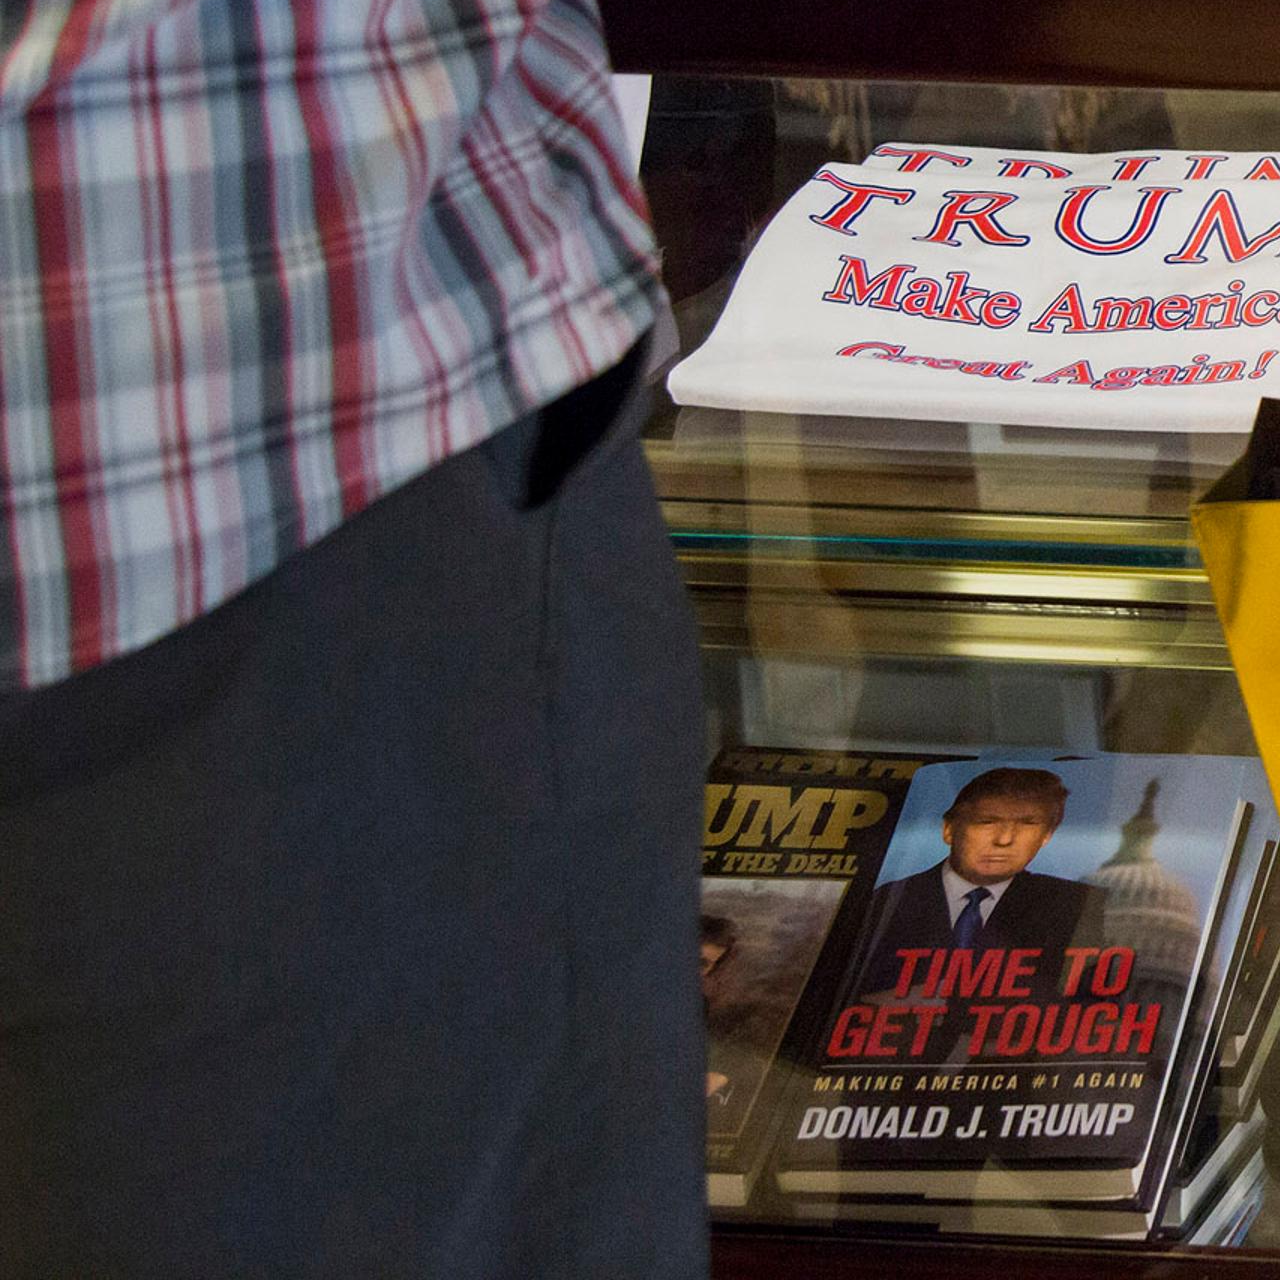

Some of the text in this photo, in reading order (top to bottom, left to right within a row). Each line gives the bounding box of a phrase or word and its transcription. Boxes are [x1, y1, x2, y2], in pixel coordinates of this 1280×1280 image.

[822, 254, 1022, 329] Make
[1032, 349, 1279, 391] Again!
[703, 783, 889, 850] UMP
[721, 851, 783, 873] THE
[785, 852, 859, 876] DEAL
[895, 946, 1137, 999] TIME TO
[826, 1003, 1162, 1058] GET TOUGH
[813, 1073, 1144, 1092] MAKING AMERICA #1 AGAIN
[797, 1103, 1136, 1140] DONALD J. TRUMP
